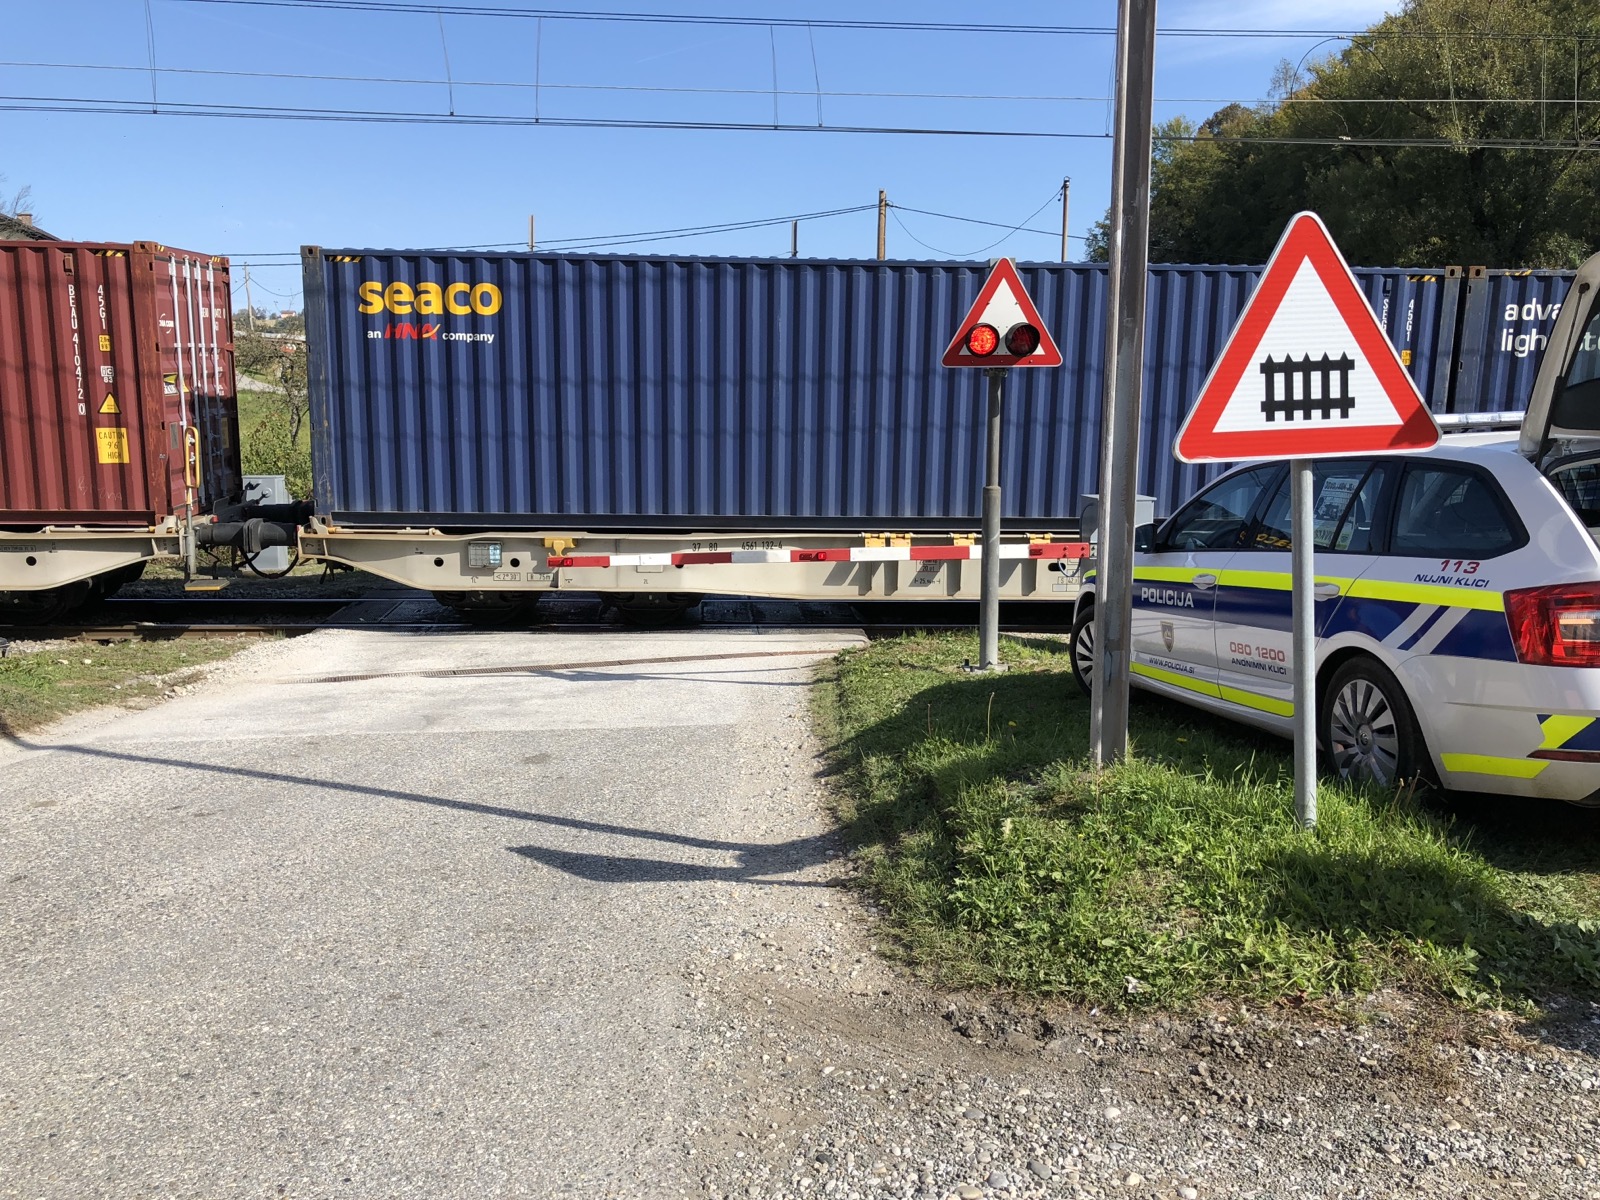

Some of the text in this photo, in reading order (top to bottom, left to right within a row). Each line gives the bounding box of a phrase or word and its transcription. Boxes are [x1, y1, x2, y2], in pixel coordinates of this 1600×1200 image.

[68, 284, 78, 329] BEAU
[97, 284, 106, 330] 45G1
[358, 281, 502, 316] seaco
[1406, 298, 1415, 342] 45G1
[367, 322, 495, 343] an HNA company
[1500, 328, 1549, 358] ligh
[72, 332, 84, 400] 410472
[98, 431, 125, 439] CAUTON
[107, 451, 121, 460] HIGH
[692, 541, 783, 551] 37 80 4561 132-4
[1440, 559, 1480, 574] 113
[1413, 574, 1490, 588] NUJNI KLICI
[1141, 586, 1195, 608] POLICIJA
[1229, 641, 1286, 663] 080 1200
[1149, 657, 1195, 675] WWW.POLICIJA.SI
[1231, 657, 1287, 675] ANONIMNI KLICI
